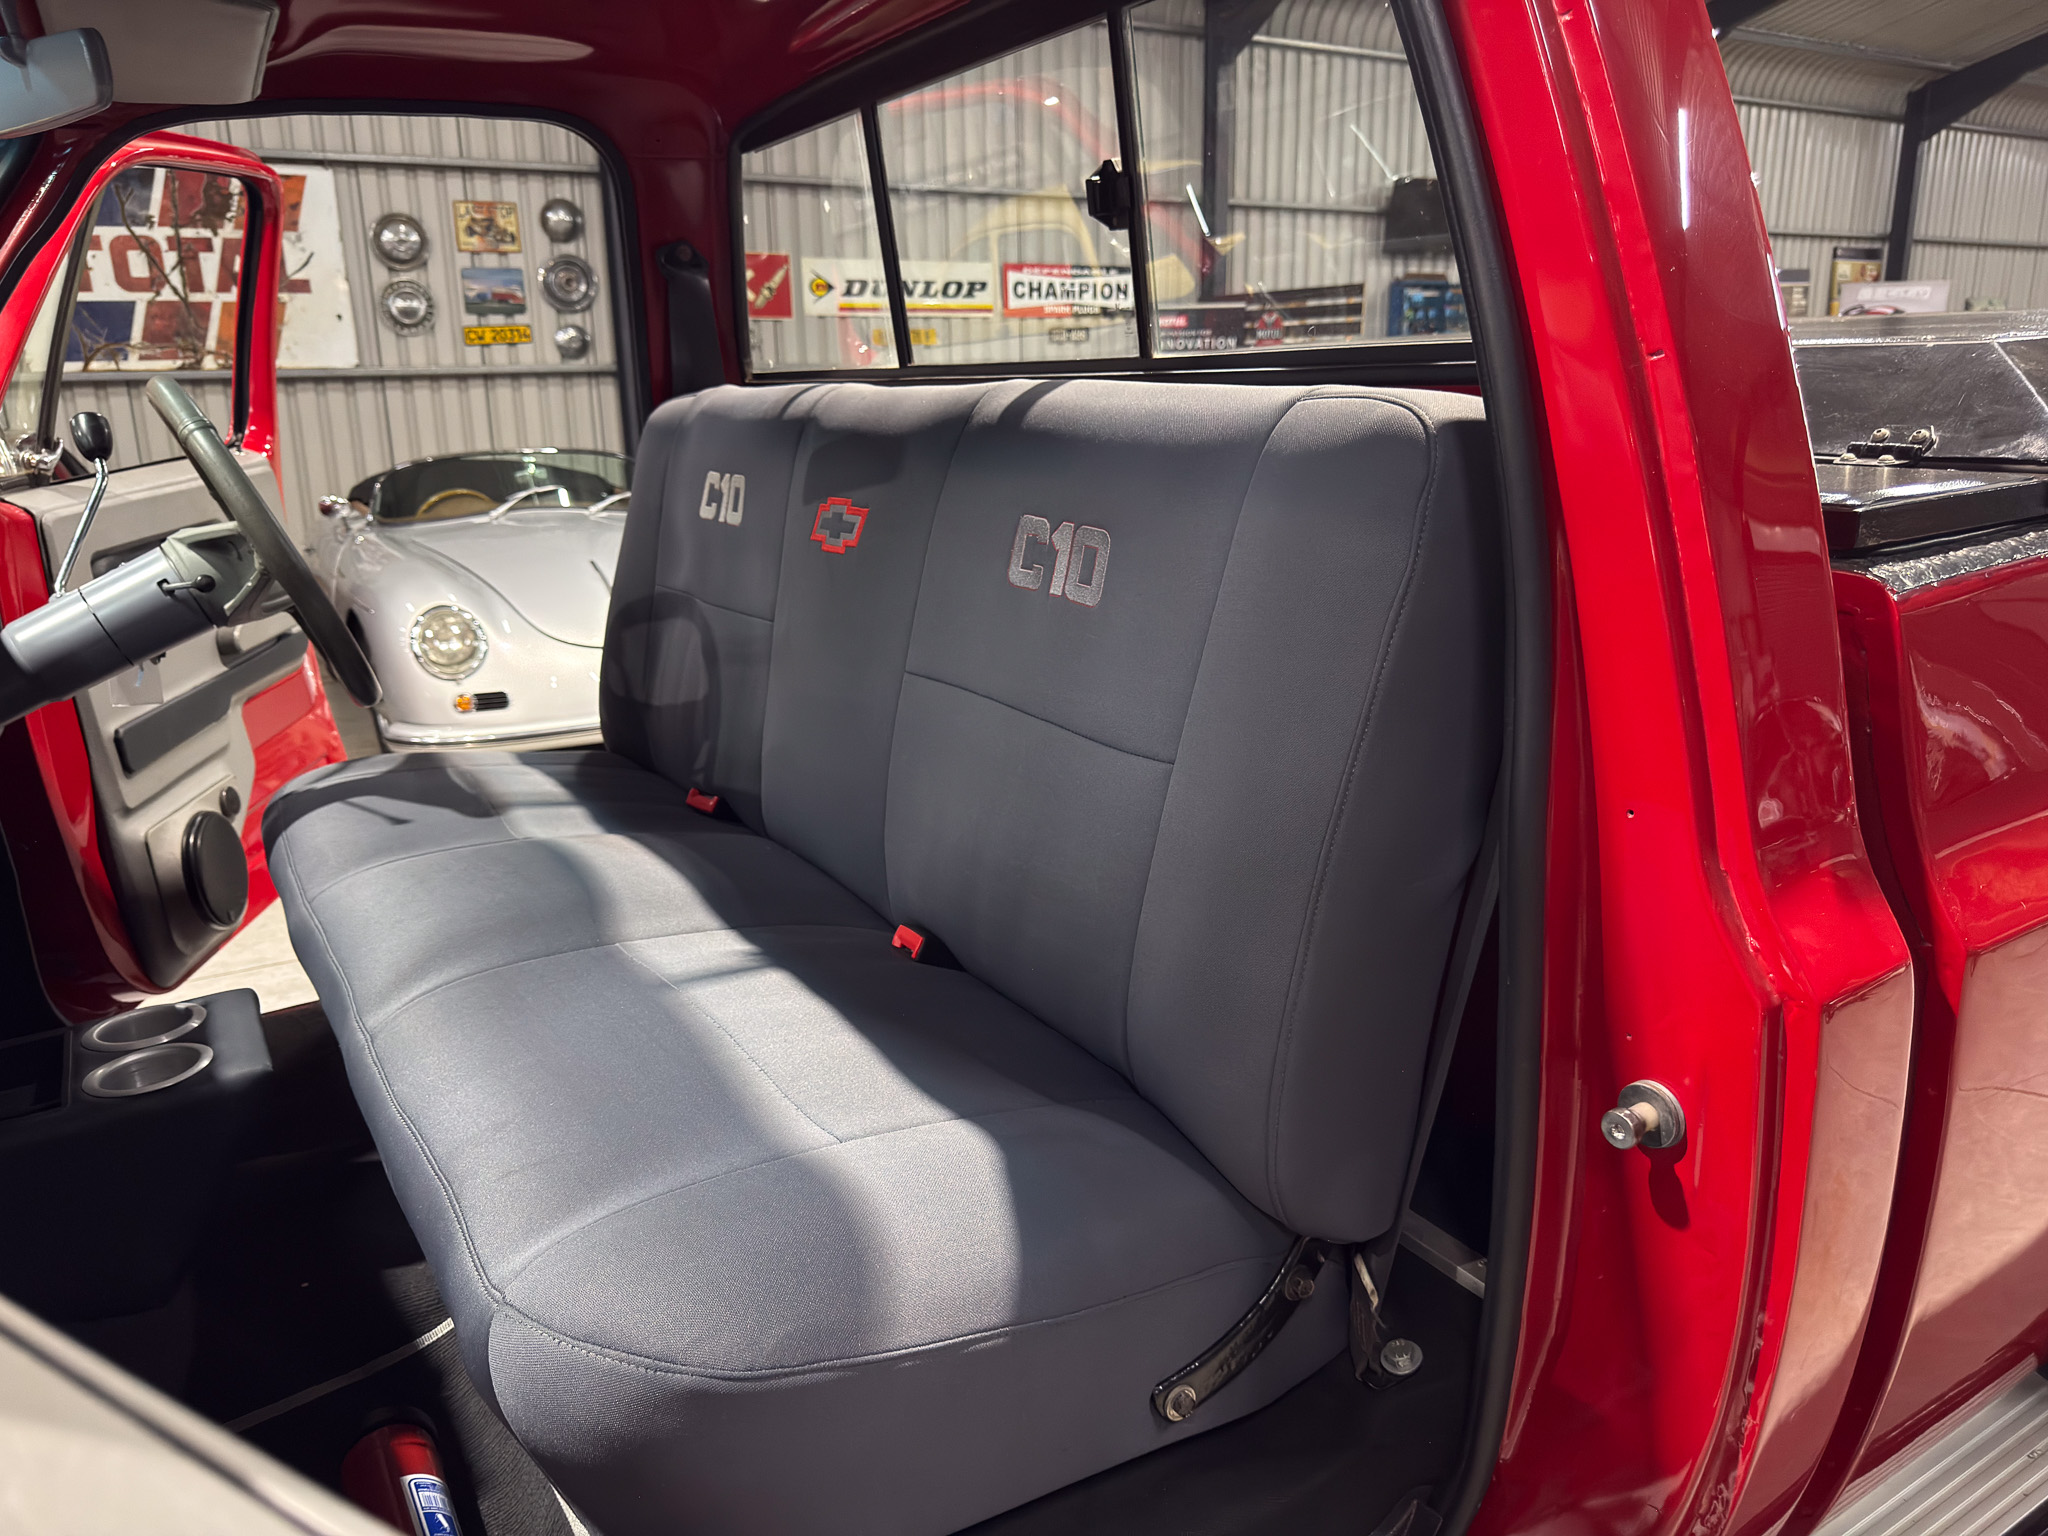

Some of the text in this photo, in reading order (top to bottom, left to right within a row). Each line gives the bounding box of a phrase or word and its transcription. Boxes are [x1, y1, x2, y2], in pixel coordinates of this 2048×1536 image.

[1013, 281, 1128, 300] CHAMPION
[699, 471, 745, 526] C10
[1007, 514, 1110, 607] C10
